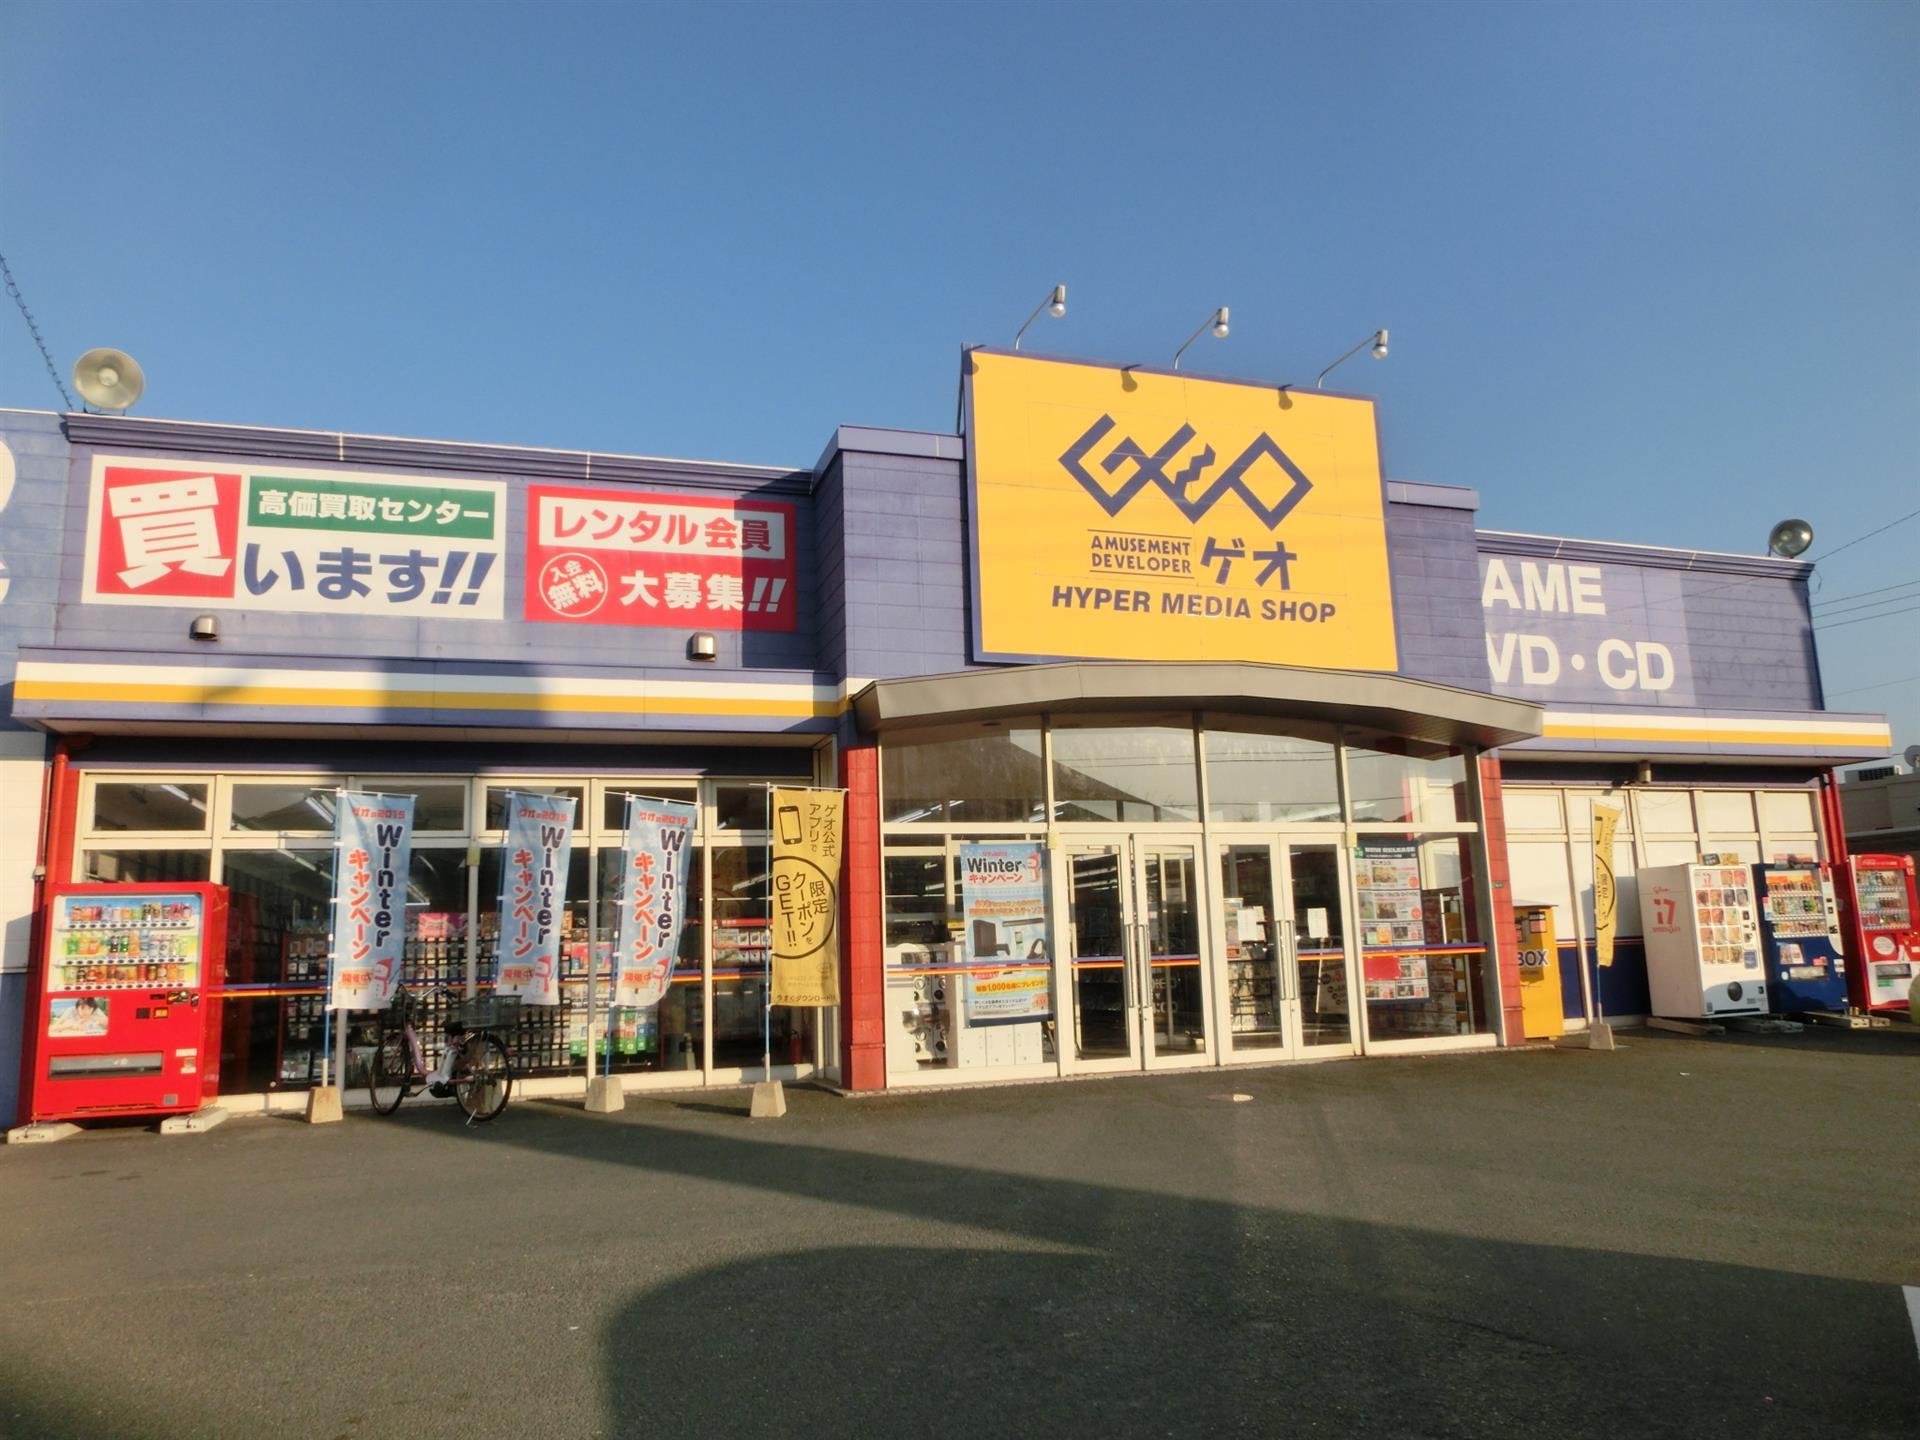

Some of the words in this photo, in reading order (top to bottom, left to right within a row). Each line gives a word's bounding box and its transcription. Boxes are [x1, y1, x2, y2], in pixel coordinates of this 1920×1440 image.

[1058, 412, 1314, 532] GEO
[108, 476, 233, 589] 買
[258, 488, 490, 526] 高価買取センター
[553, 506, 772, 552] レンタル会員
[551, 559, 583, 583] 入会
[1091, 535, 1191, 556] AMUSEMENT
[1091, 553, 1192, 574] DEVELOPER
[1200, 537, 1298, 590] ゲオ
[547, 568, 605, 612] 無料
[1052, 585, 1151, 613] HYPER
[1161, 593, 1251, 619] MEDIA
[1261, 600, 1336, 624] SHOP
[808, 803, 821, 853] アプリで
[822, 804, 837, 858] ゲオ公式
[374, 824, 403, 947] Winter
[537, 825, 565, 945] Winter
[657, 828, 686, 948] Winter
[967, 857, 1023, 873] Winter
[968, 872, 1024, 884] キャンペーン
[349, 849, 371, 960] キャンペーン
[514, 849, 534, 957] キャンペーン
[634, 852, 655, 960] キャンペーン
[792, 872, 815, 945] クーポンを
[809, 879, 830, 915] 限定
